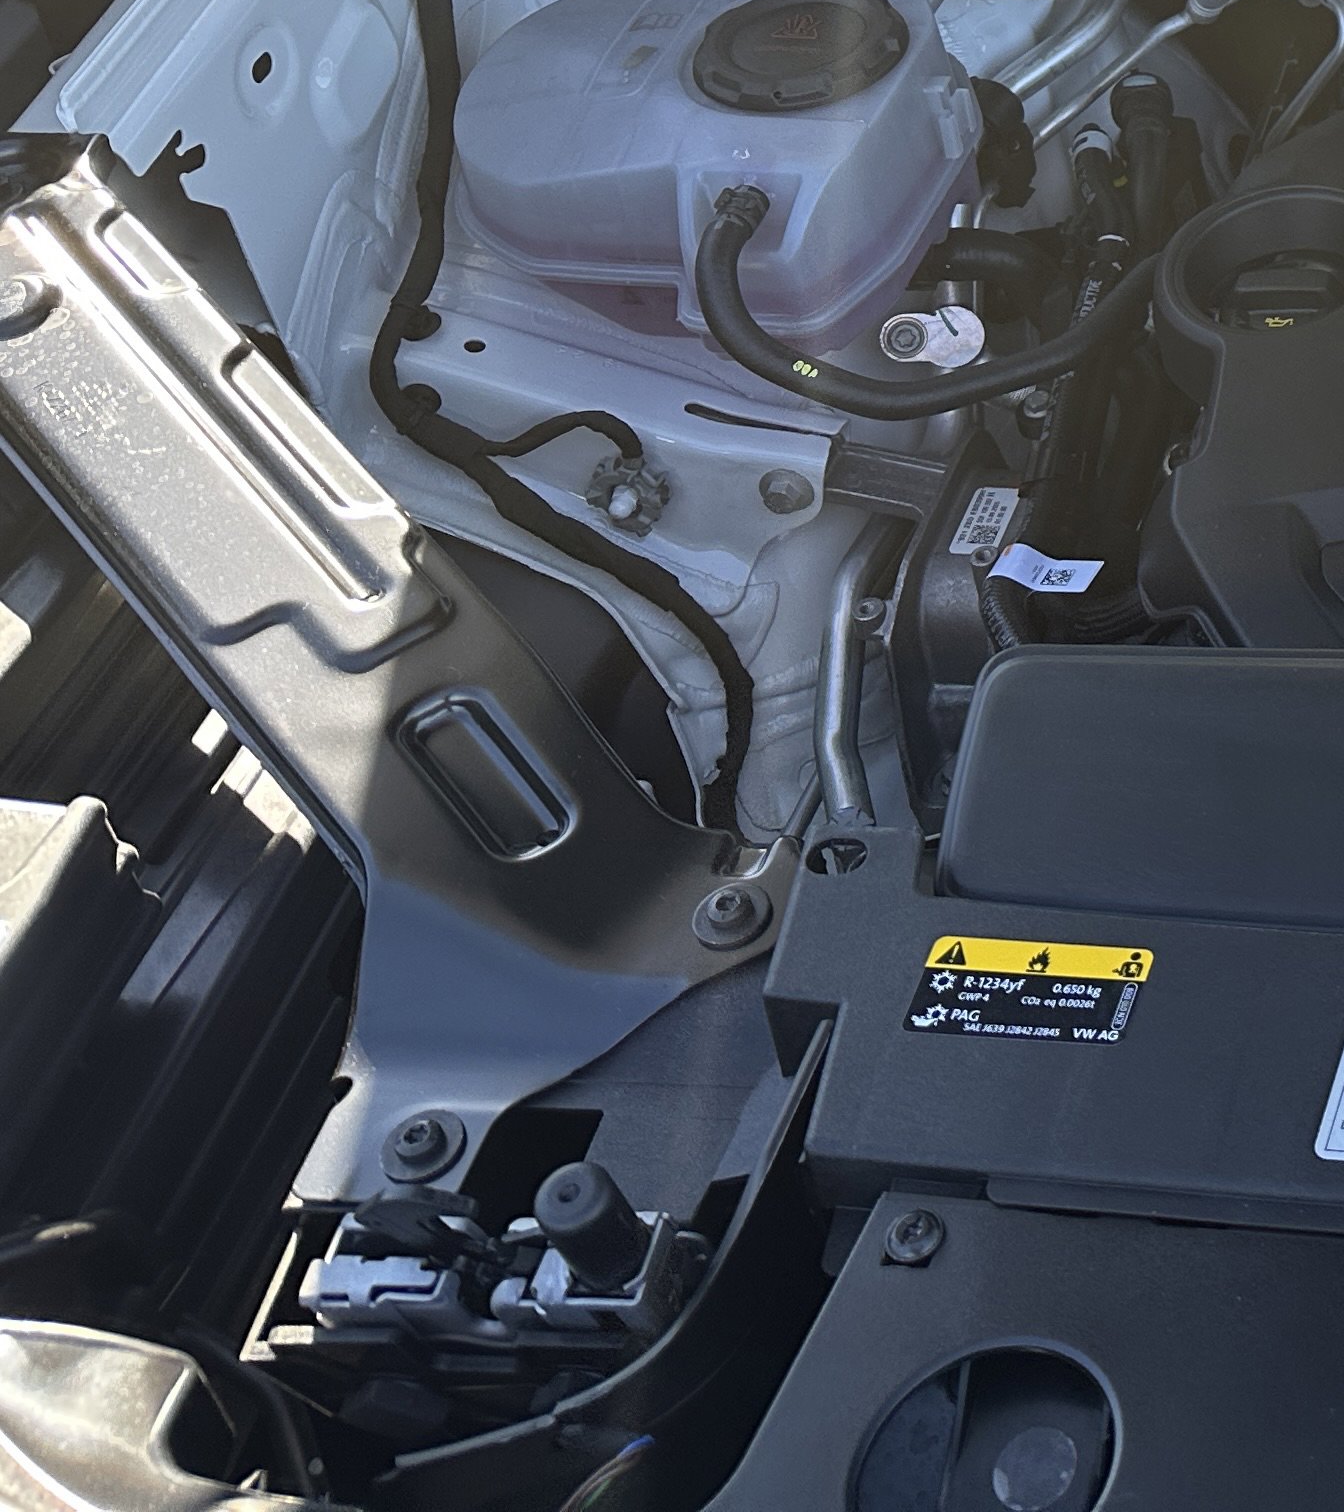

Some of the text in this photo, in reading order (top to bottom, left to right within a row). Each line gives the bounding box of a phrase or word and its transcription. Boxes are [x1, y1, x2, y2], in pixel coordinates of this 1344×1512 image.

[964, 976, 1102, 998] R-1234yf 0.650 kg
[950, 1008, 980, 1022] PAG
[1072, 1028, 1119, 1041] VW AG
